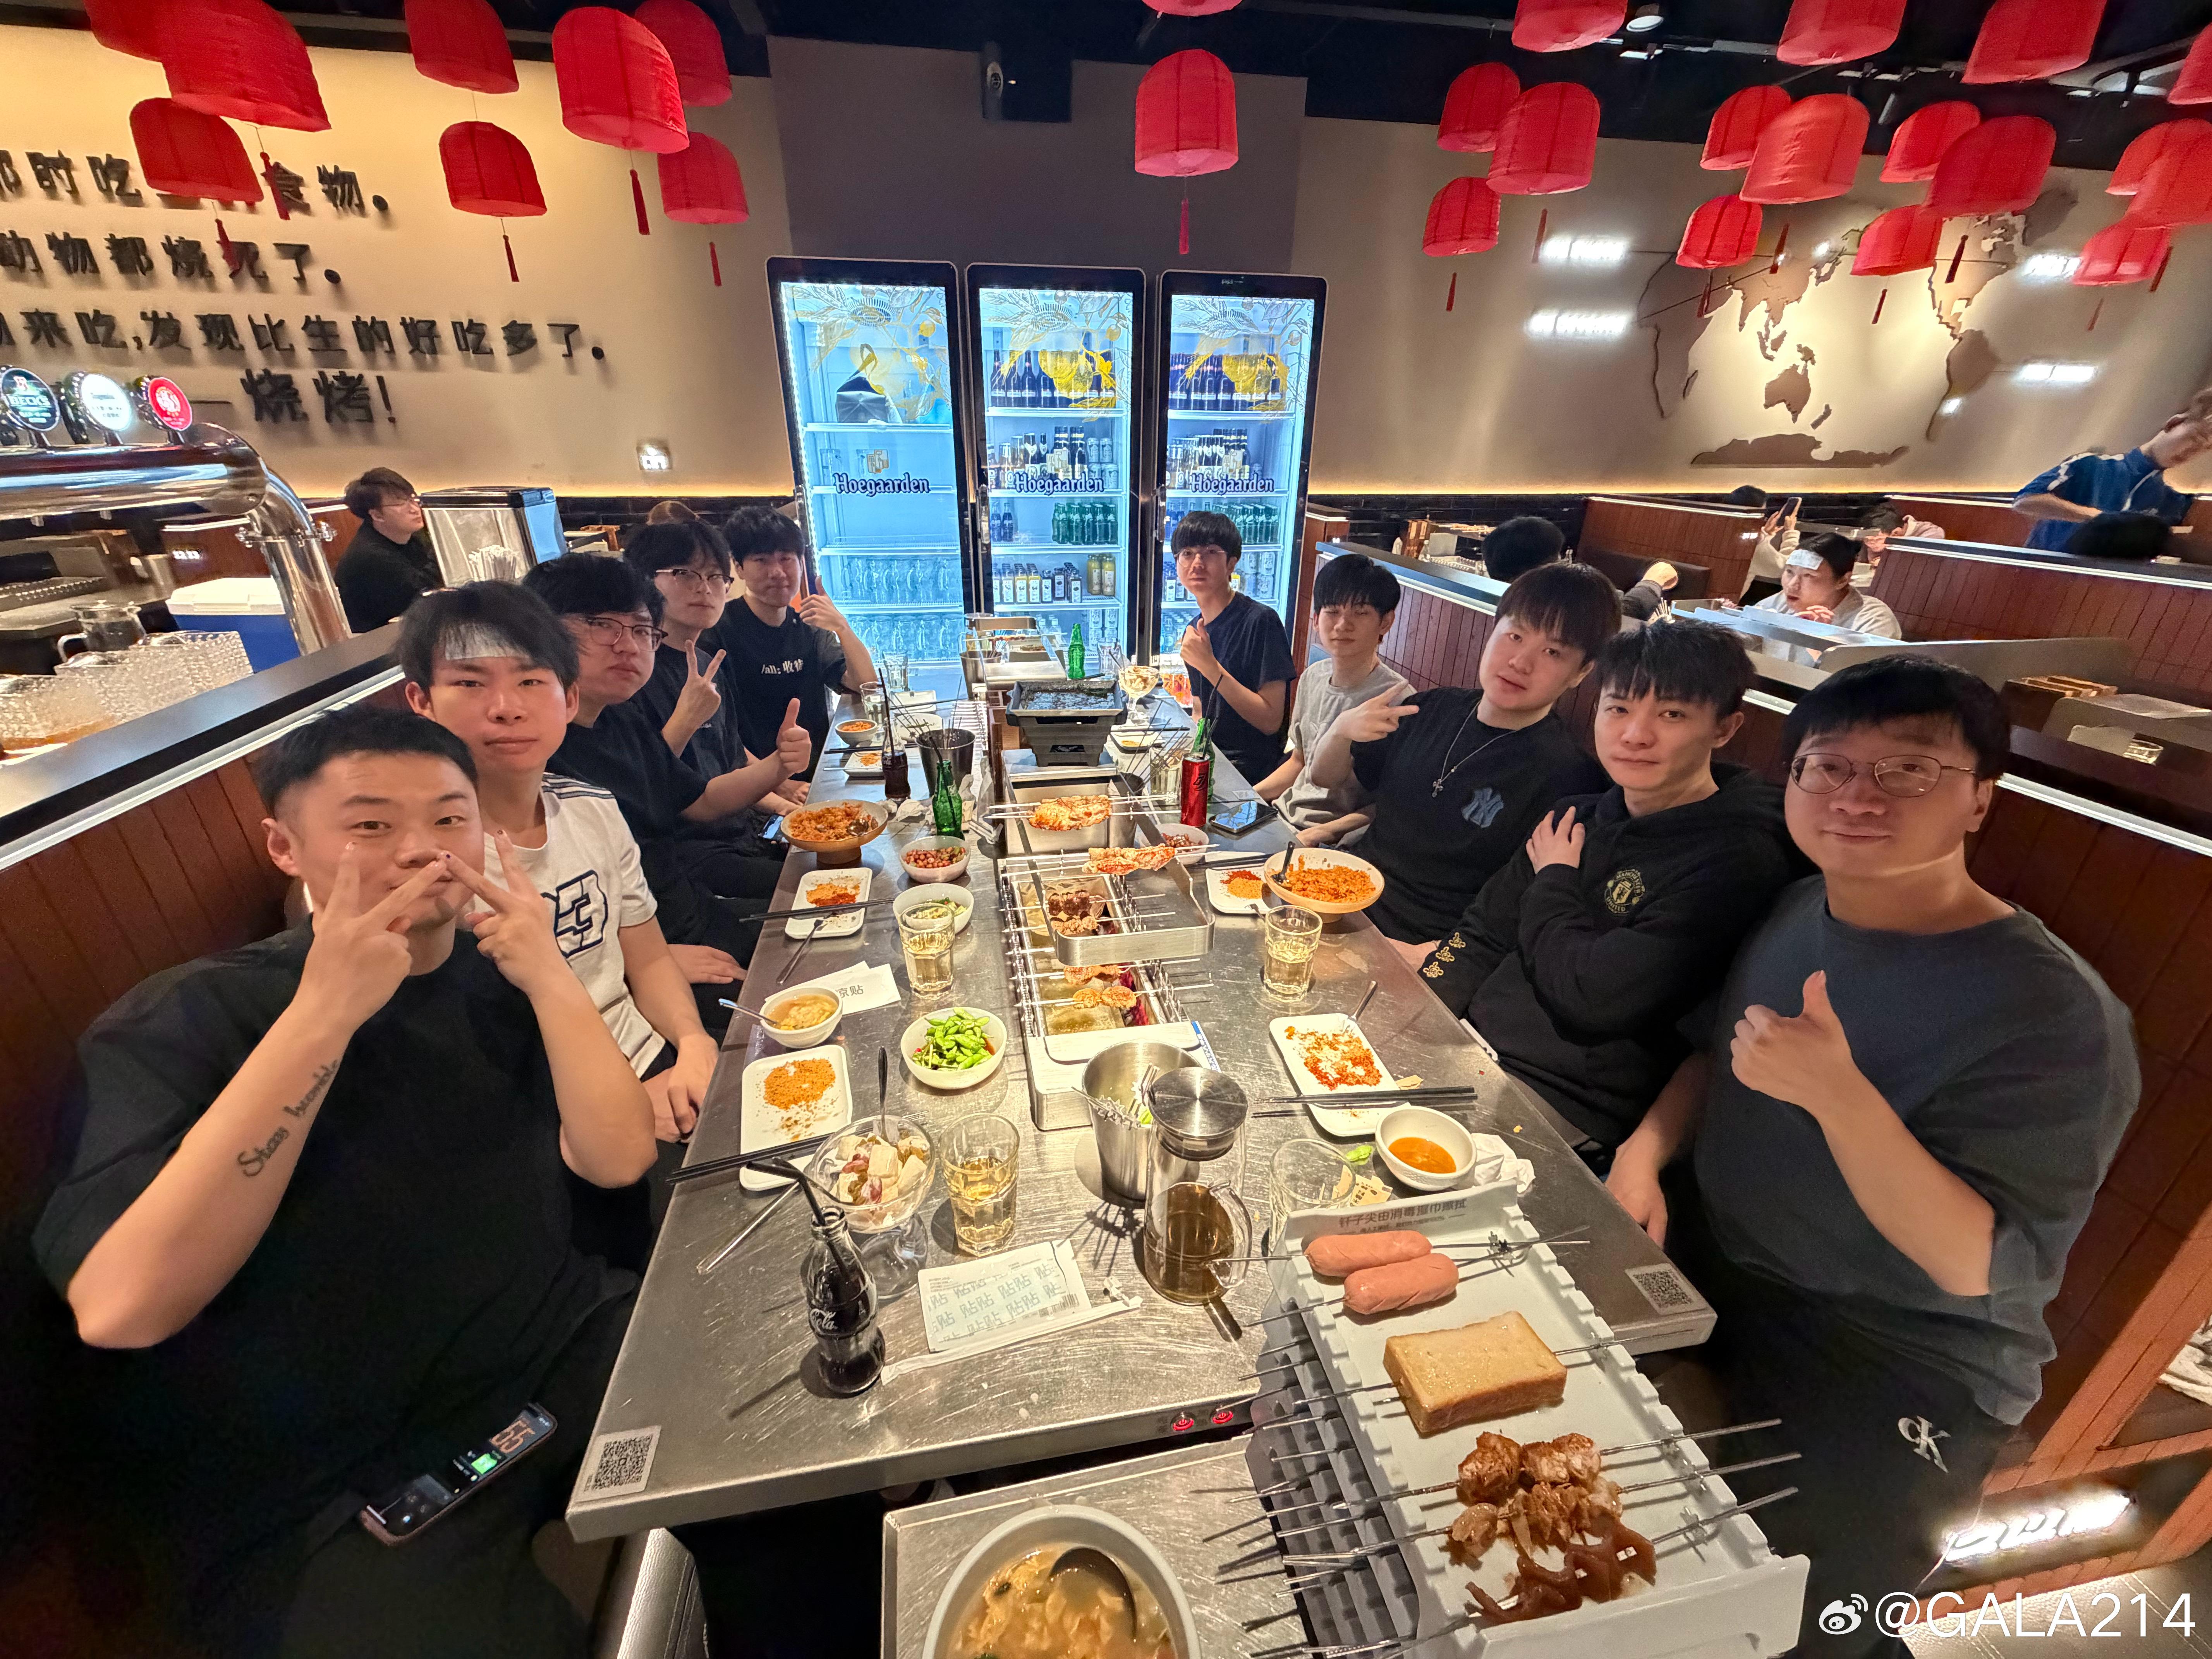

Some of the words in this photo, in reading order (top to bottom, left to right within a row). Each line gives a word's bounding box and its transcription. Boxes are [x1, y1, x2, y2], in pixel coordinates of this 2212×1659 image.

[8, 395, 51, 406] BECK'S
[833, 472, 931, 497] Hoegaarden
[1013, 472, 1104, 496] Hoegaarden
[1191, 471, 1274, 496] Hoegaarden
[1462, 787, 1504, 828] NY
[1606, 896, 1626, 912] UNITED
